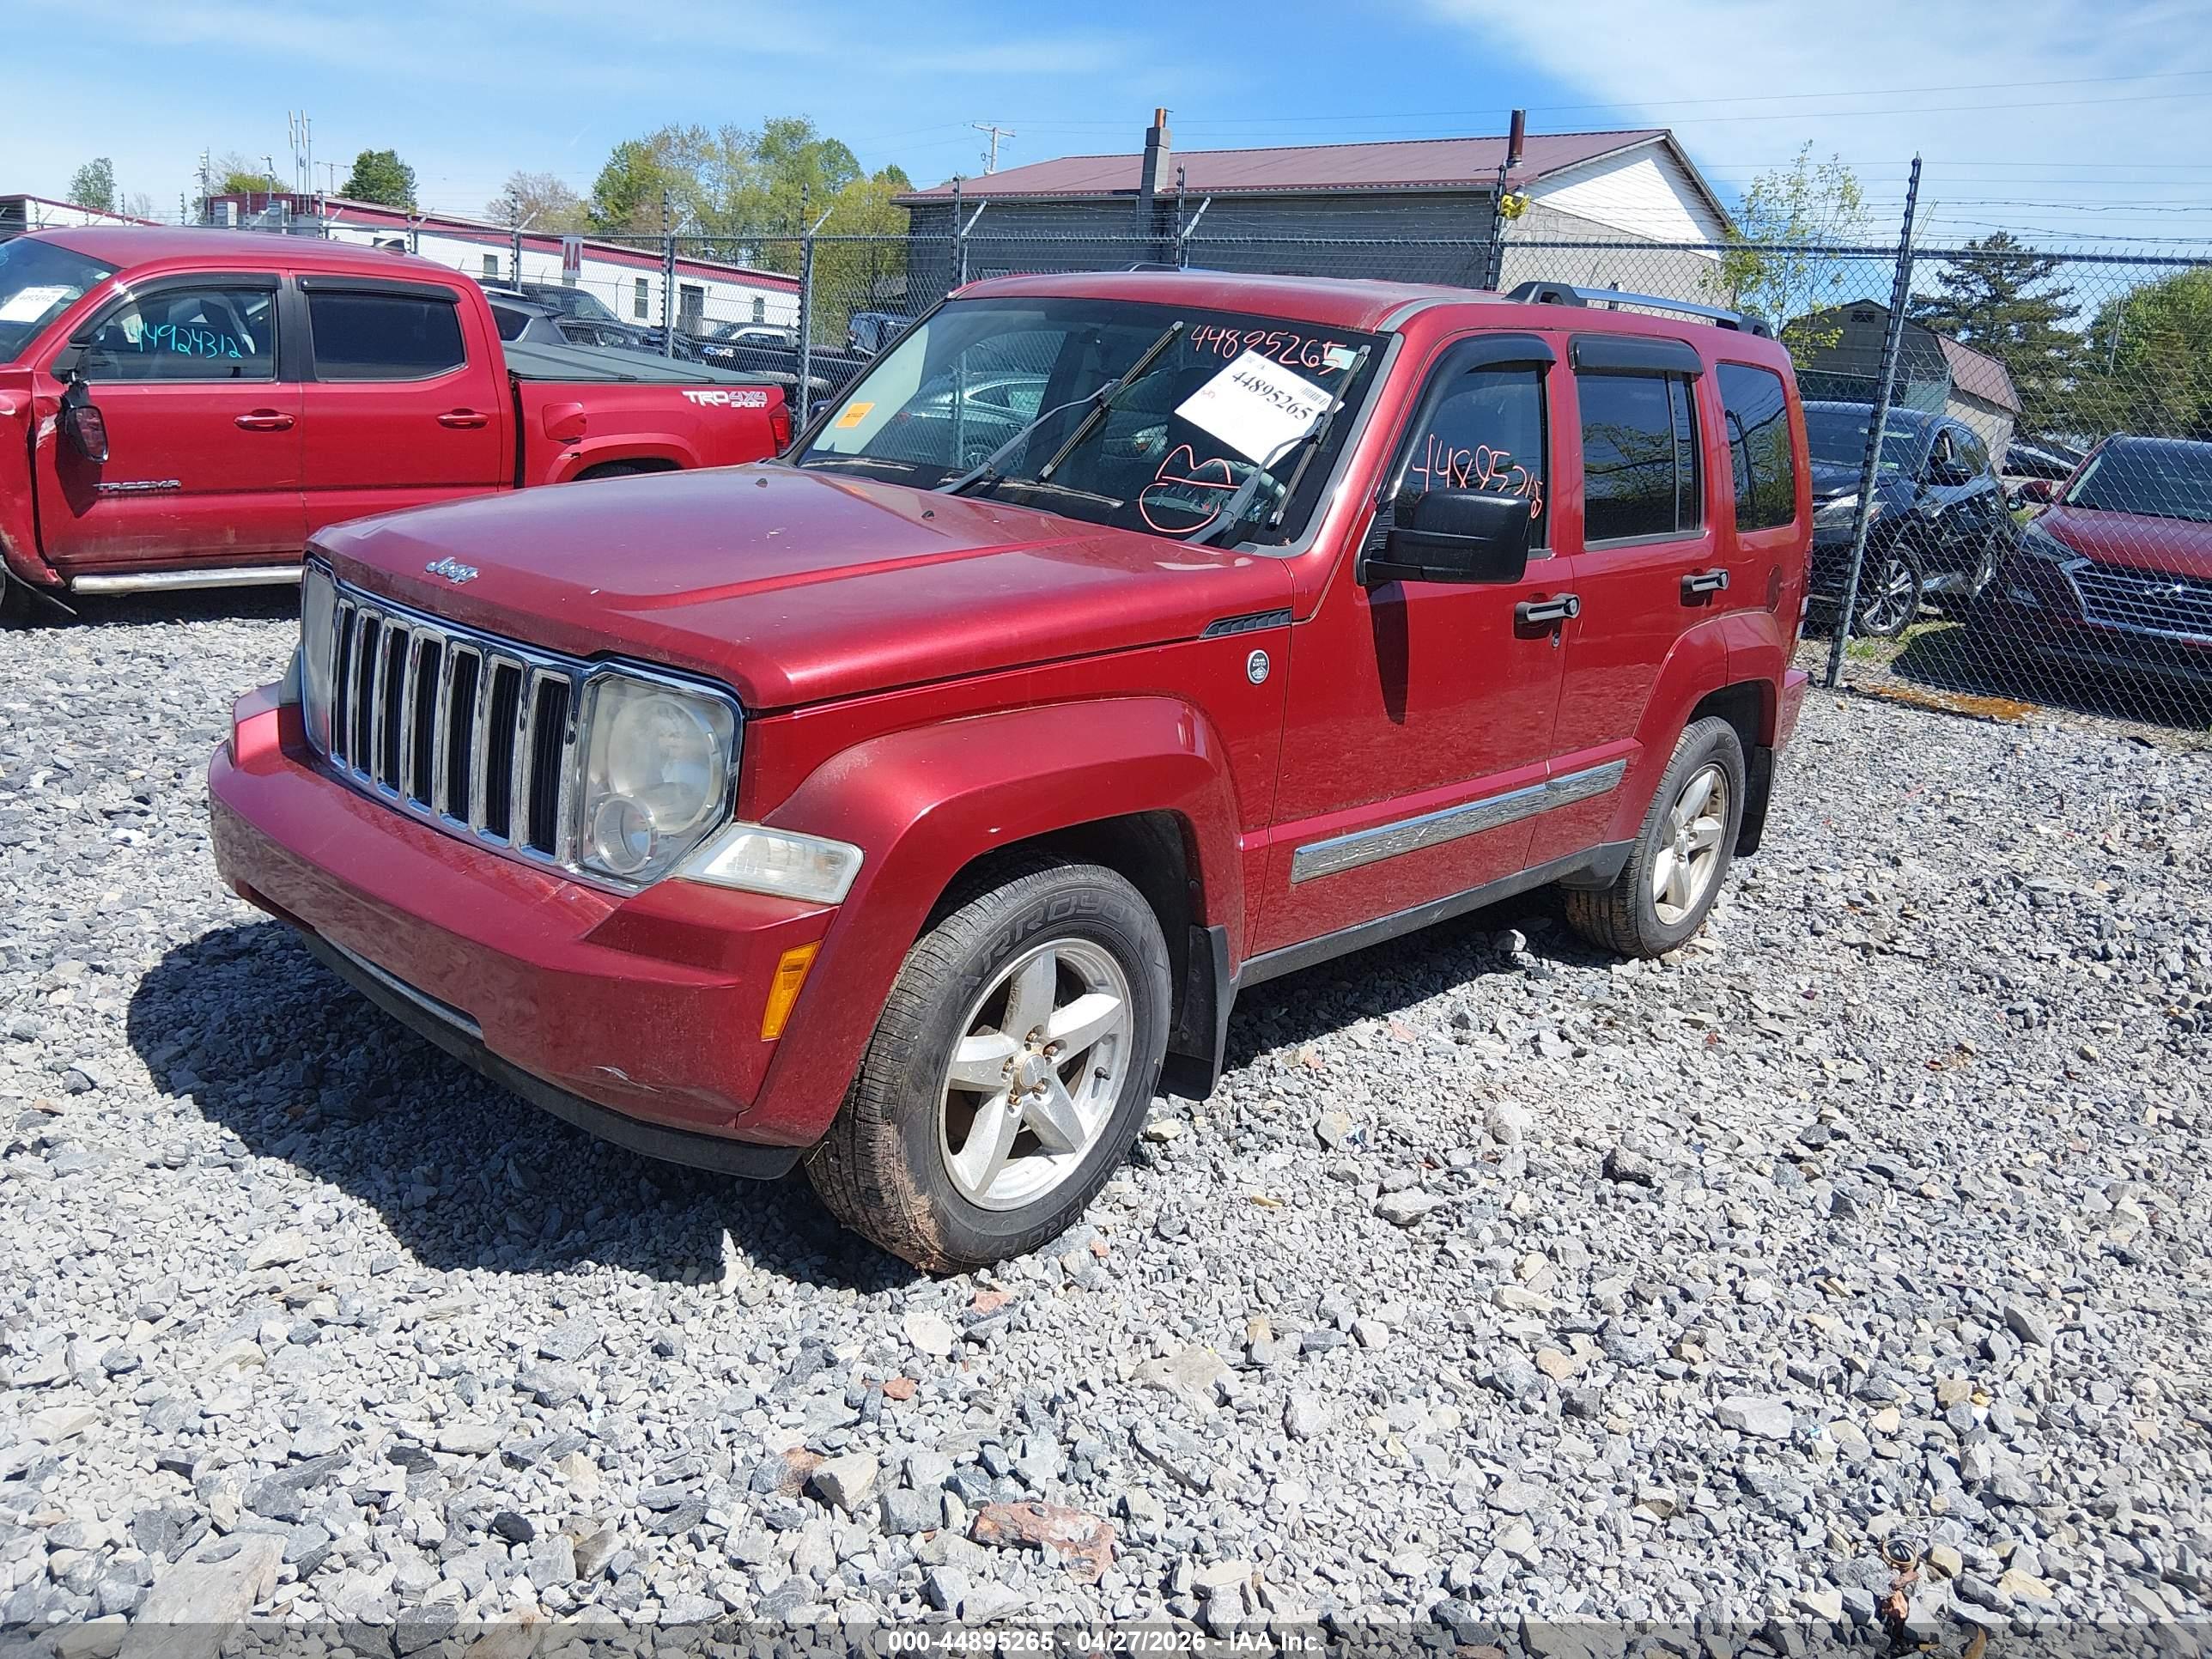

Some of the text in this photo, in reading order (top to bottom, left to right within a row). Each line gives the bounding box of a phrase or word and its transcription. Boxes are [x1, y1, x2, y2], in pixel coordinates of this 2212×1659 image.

[1190, 325, 1347, 376] 44895265
[682, 391, 730, 407] TRD
[1231, 371, 1314, 421] 44895265
[93, 479, 182, 490] TACOMA
[425, 556, 478, 585] Jeep
